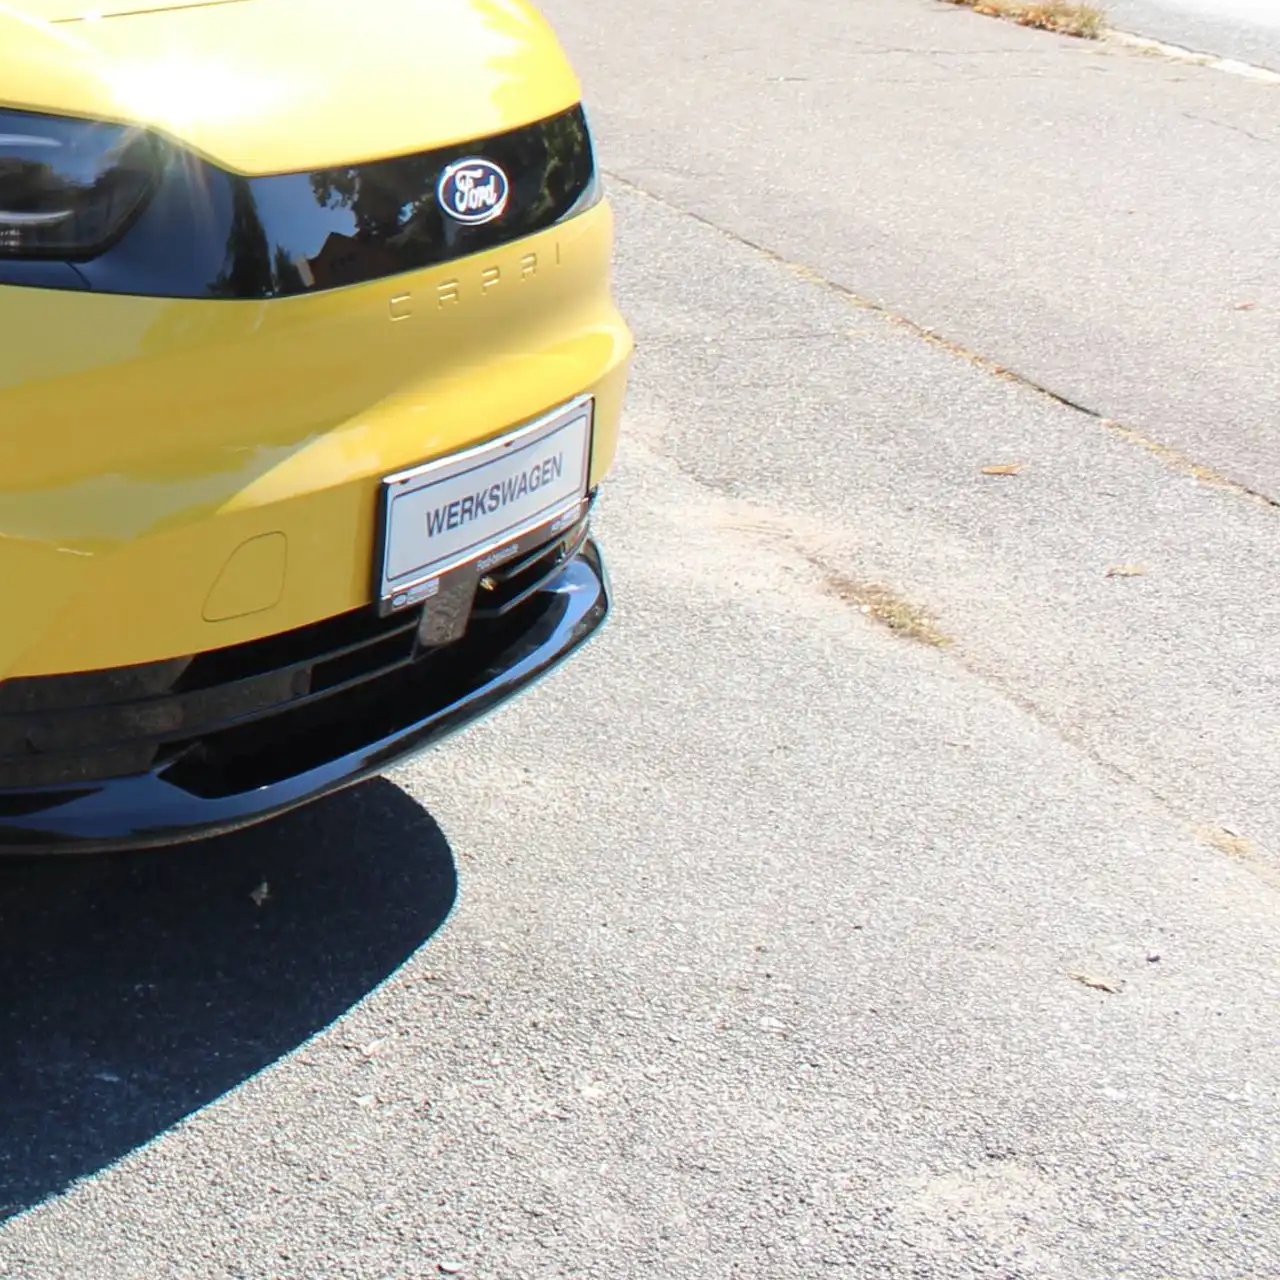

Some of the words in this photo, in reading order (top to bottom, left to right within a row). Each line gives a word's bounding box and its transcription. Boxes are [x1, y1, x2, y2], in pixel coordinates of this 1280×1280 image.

[454, 169, 498, 213] Ford
[388, 241, 561, 323] CAPRI
[425, 452, 564, 538] WERKSWAGEN
